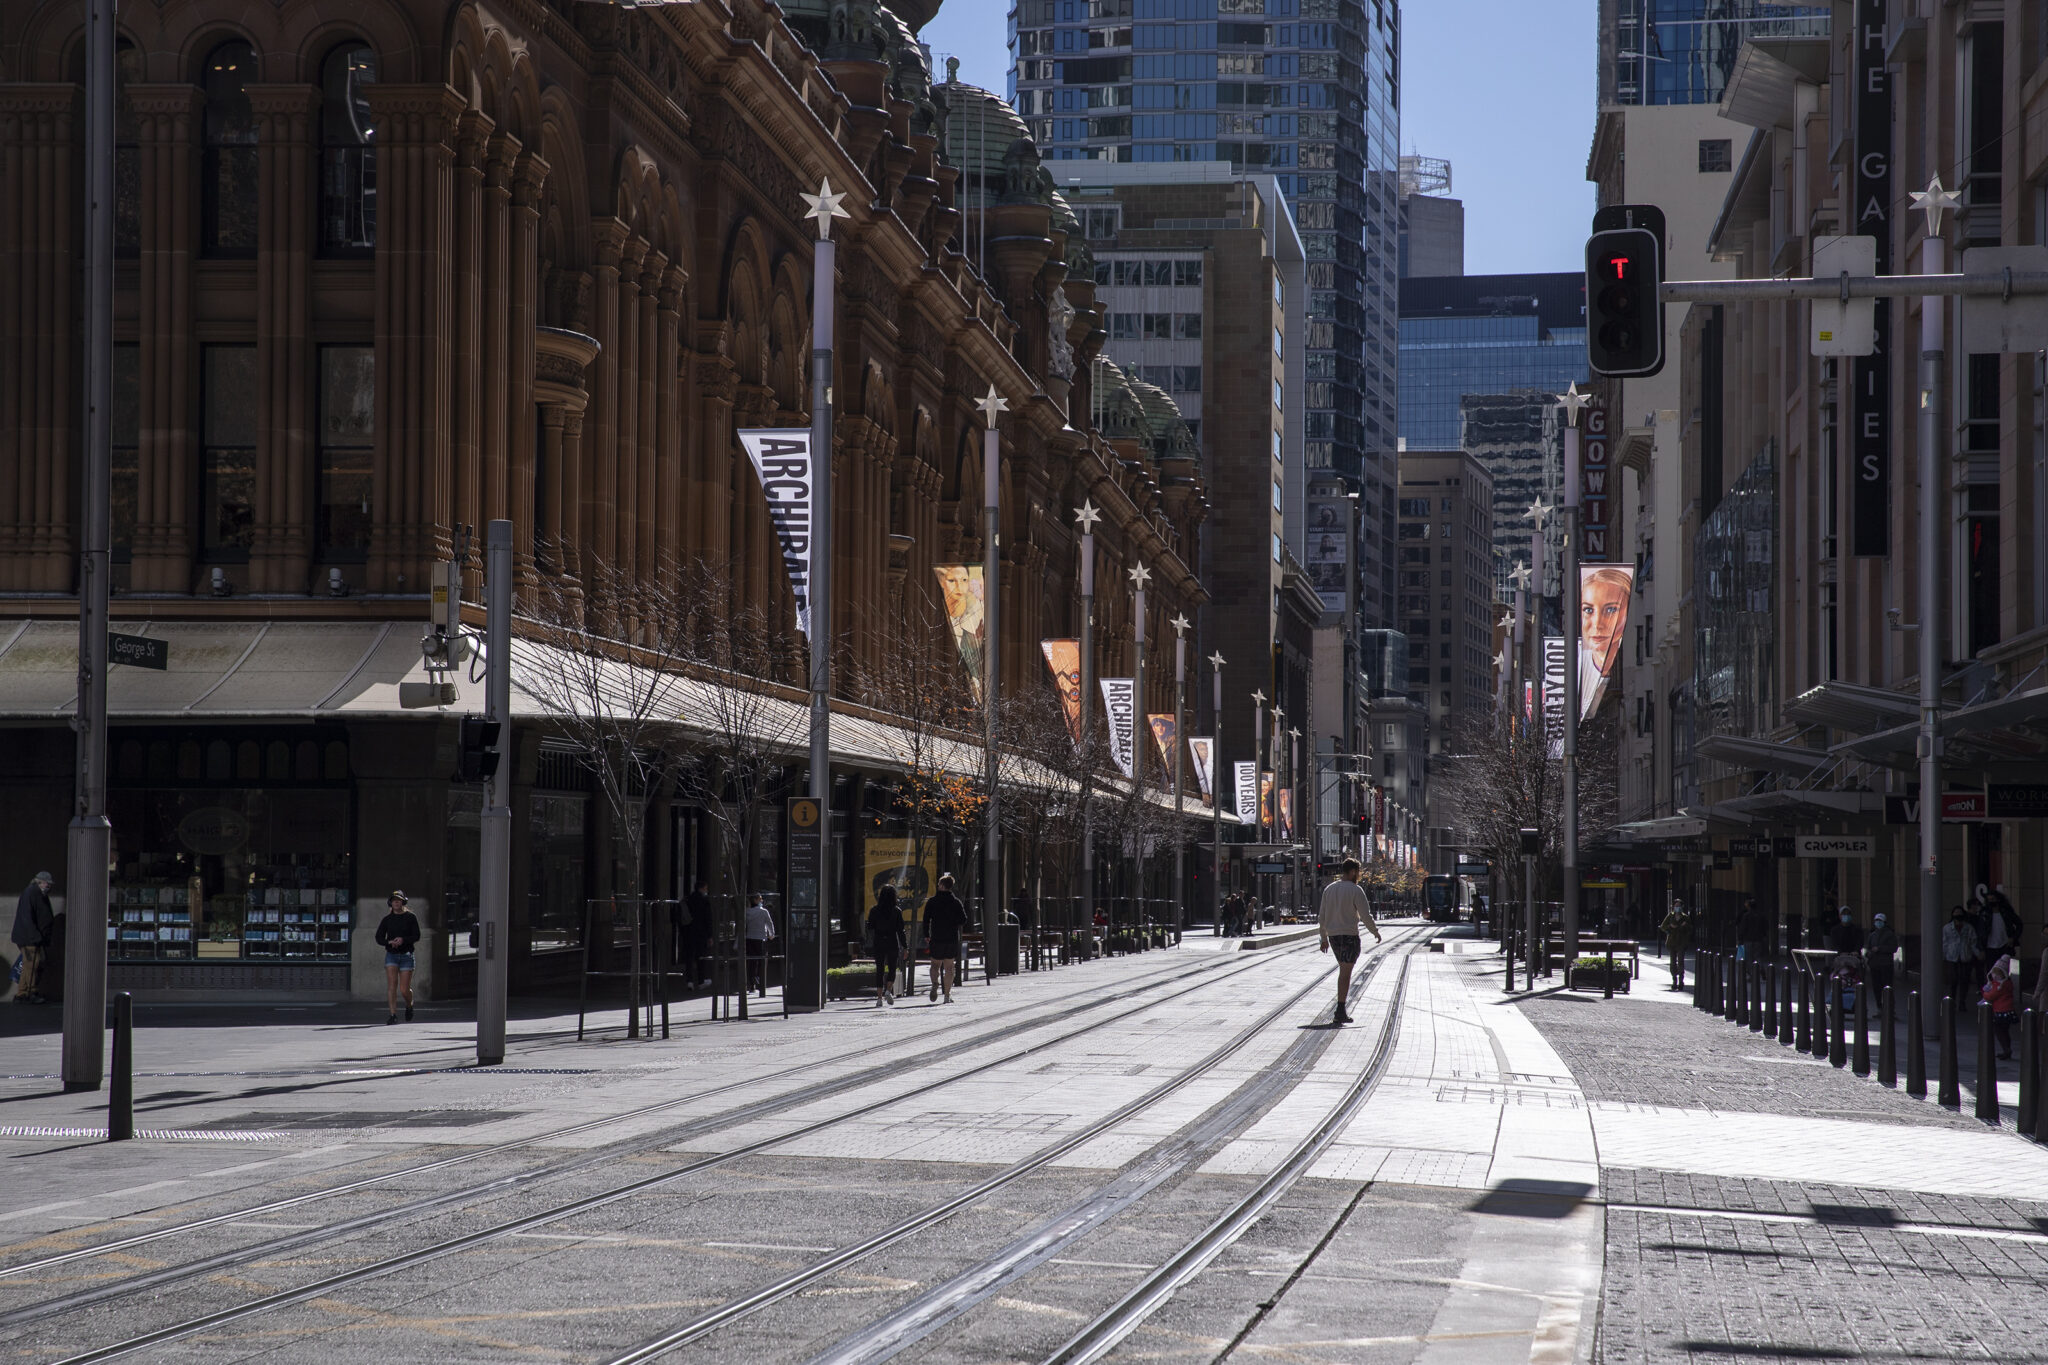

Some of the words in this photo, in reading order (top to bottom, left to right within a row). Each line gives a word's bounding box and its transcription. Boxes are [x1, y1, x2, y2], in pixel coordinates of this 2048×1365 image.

[1865, 0, 1886, 92] HE
[1861, 153, 1887, 481] GAIES
[114, 637, 145, 659] George
[146, 641, 155, 657] St
[1240, 764, 1254, 782] 100
[1240, 783, 1255, 815] YEARS
[1902, 800, 1921, 823] V
[1804, 841, 1867, 852] CRUMPLER
